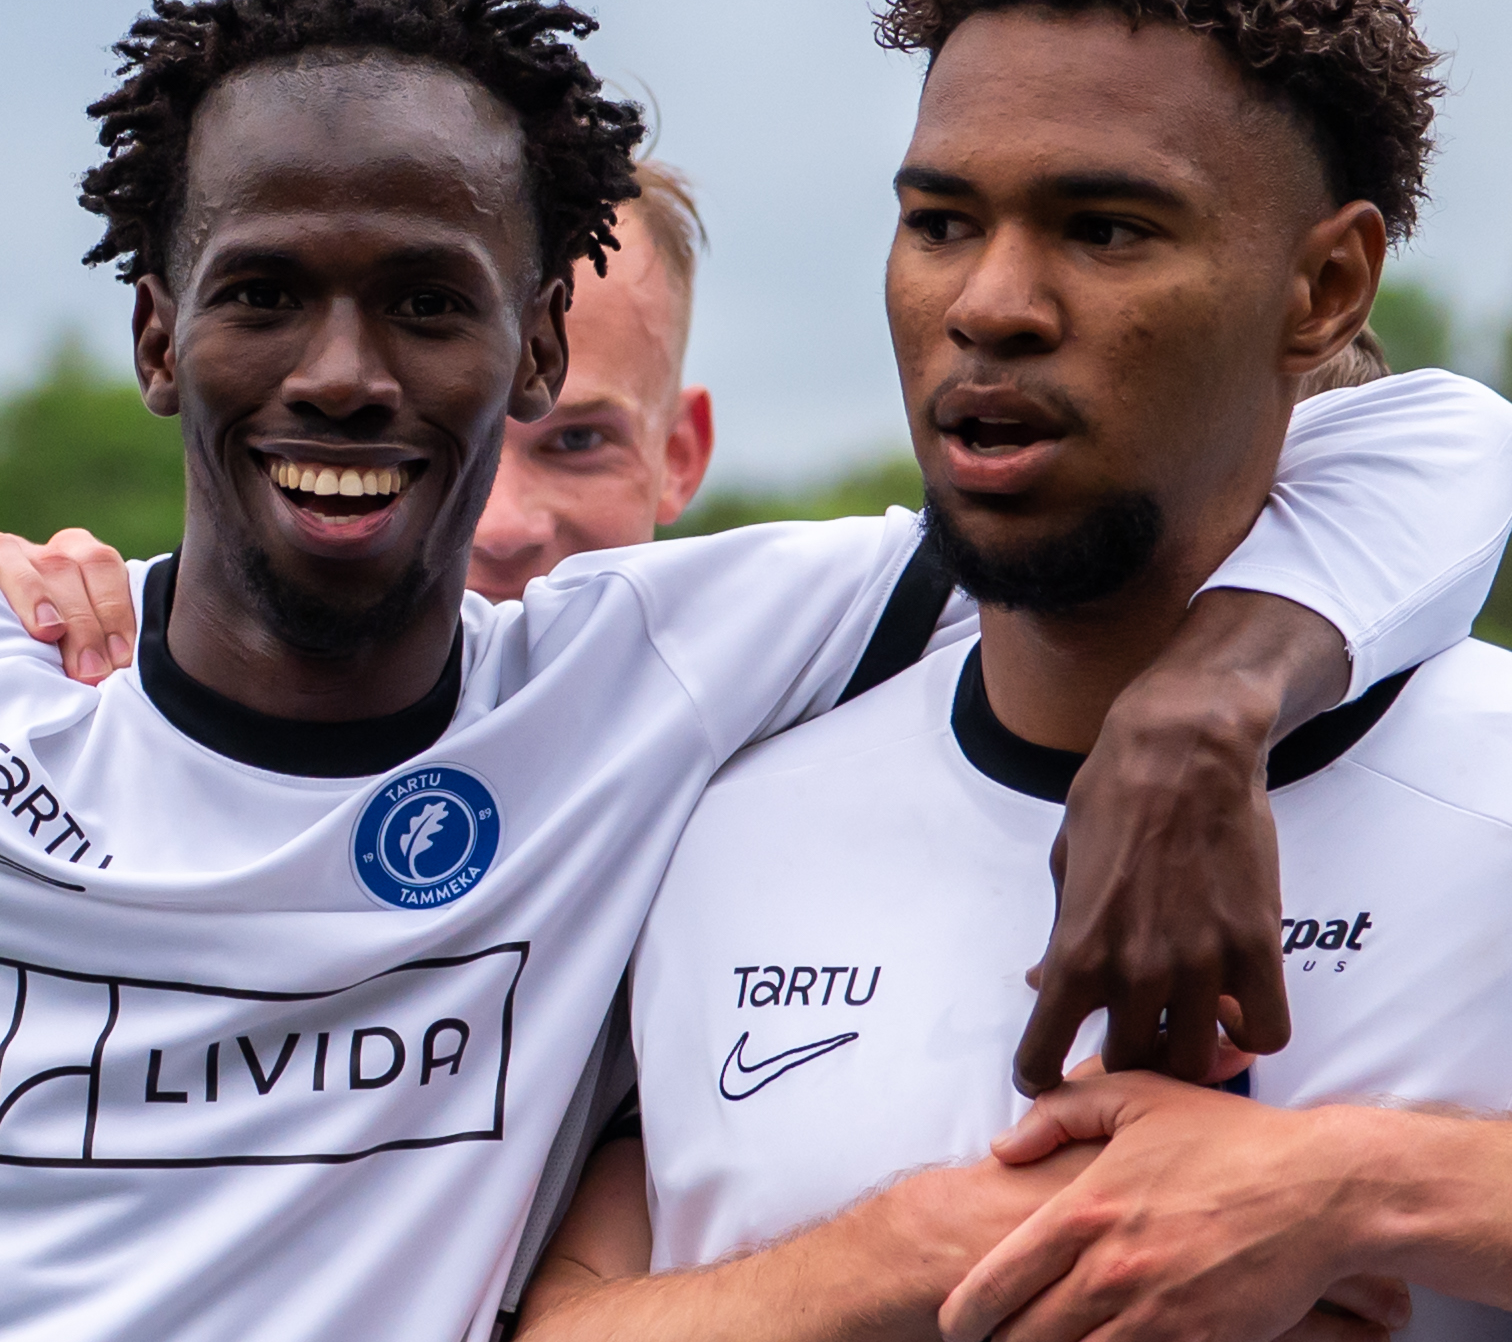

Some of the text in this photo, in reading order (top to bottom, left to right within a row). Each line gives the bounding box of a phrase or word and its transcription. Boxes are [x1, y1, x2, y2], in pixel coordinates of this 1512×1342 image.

[385, 773, 441, 802] TARTU
[478, 807, 492, 821] 89
[362, 852, 374, 864] 19
[399, 866, 482, 905] TAMMEKA
[144, 1017, 470, 1104] LIVIDA
